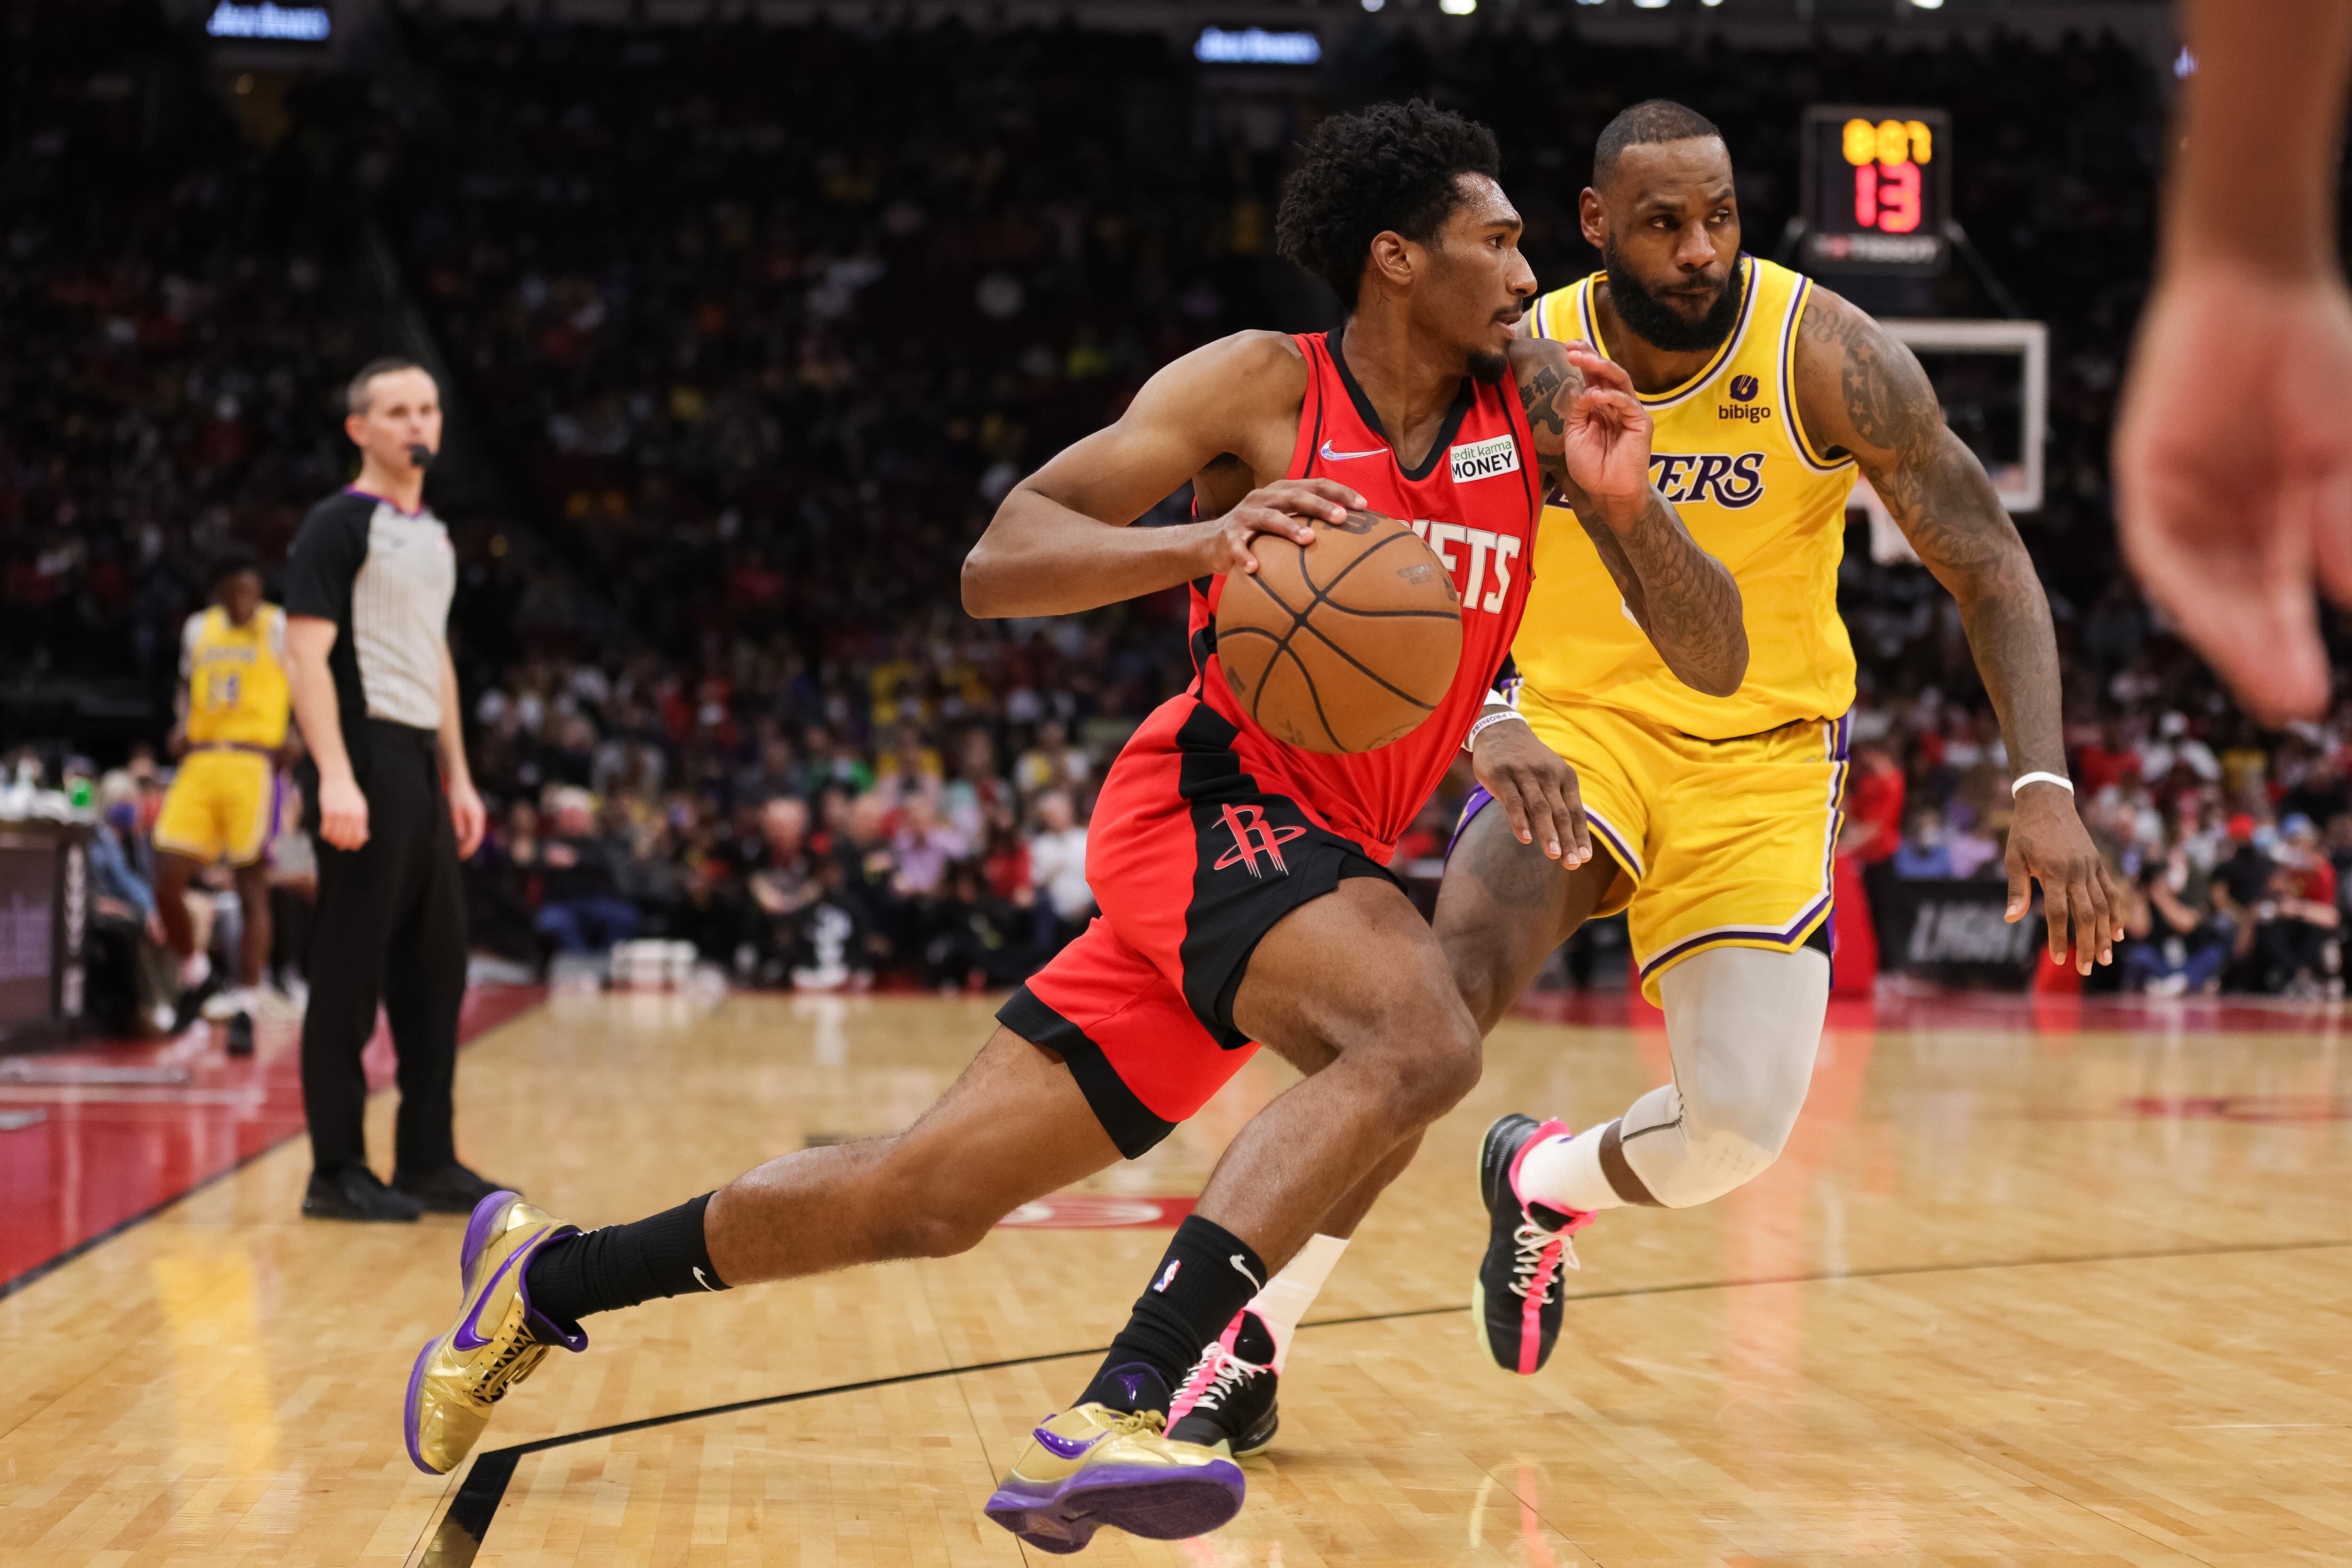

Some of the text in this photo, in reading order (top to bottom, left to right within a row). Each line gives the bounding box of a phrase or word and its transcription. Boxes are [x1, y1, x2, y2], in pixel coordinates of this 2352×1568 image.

[1856, 161, 1921, 233] 13
[1719, 405, 1771, 423] bibigo
[1451, 441, 1511, 461] redit karma
[1452, 451, 1512, 479] MONEY
[1471, 714, 1507, 736] PROMISE
